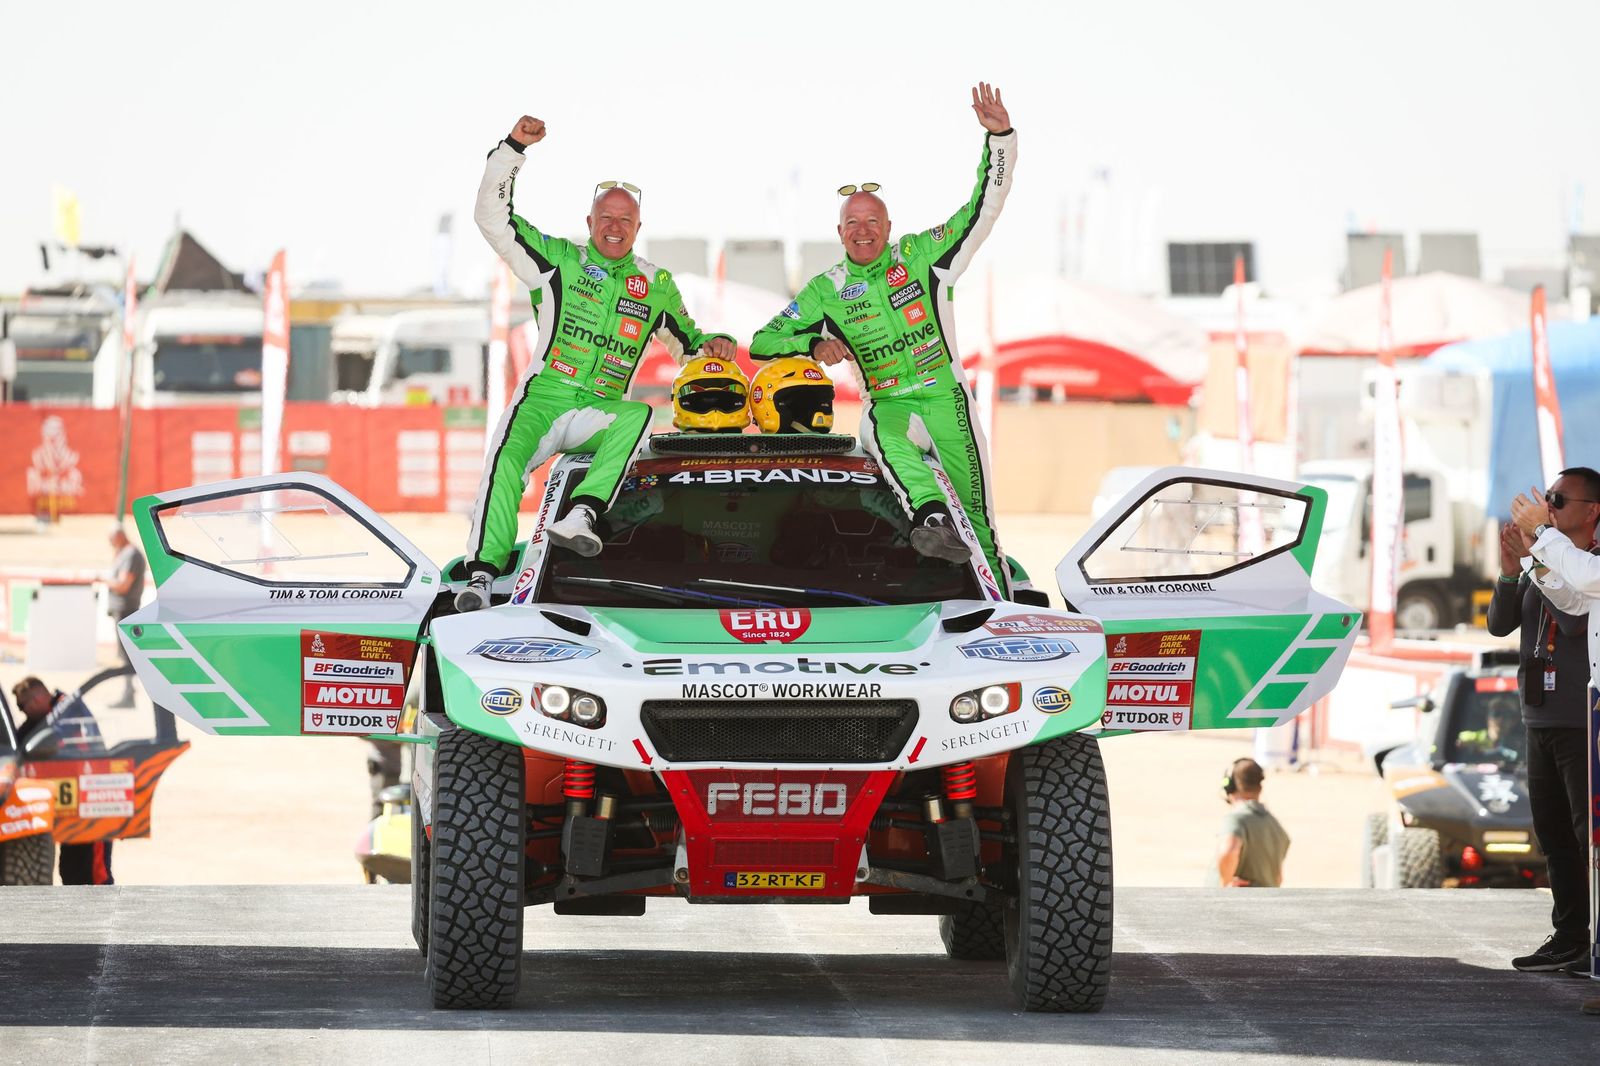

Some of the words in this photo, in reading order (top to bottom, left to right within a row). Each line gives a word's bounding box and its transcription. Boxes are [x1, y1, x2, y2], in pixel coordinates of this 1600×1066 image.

[568, 284, 594, 298] KEUKEN
[577, 276, 604, 293] DHG
[628, 278, 646, 294] ERU
[893, 288, 922, 308] WORKWEAR
[618, 306, 648, 319] WORKWEAR
[845, 300, 872, 315] DHG
[908, 307, 924, 320] JBL
[844, 313, 868, 325] KEUKEN
[624, 322, 638, 336] JBL
[562, 318, 638, 359] Emotive
[859, 322, 935, 363] Emotive
[552, 360, 574, 374] FEBO
[705, 364, 722, 372] ERU
[805, 370, 822, 379] ERU
[681, 458, 732, 466] DREAM.
[965, 443, 981, 514] WORKWEAR
[269, 590, 293, 599] TIM
[295, 590, 306, 599] &
[309, 590, 338, 599] TOM
[342, 590, 404, 599] CORONEL
[1091, 587, 1116, 596] TIM
[1127, 584, 1157, 594] TOM
[1158, 582, 1216, 593] CORONEL
[730, 609, 802, 630] ERU
[360, 639, 393, 648] DREAM.
[314, 663, 394, 675] BFGoodrich
[642, 658, 918, 675] Emotive
[1111, 662, 1186, 672] BFGoodrich
[316, 687, 392, 704] MOTUL
[772, 683, 881, 698] WORKWEAR
[1108, 685, 1180, 701] MOTUL
[485, 696, 522, 706] HELLA
[1036, 694, 1072, 704] HELLA
[326, 715, 383, 727] TUDOR
[1116, 712, 1169, 723] TUDOR
[524, 721, 613, 751] SERENGETI
[941, 720, 1028, 751] SERENGETI
[707, 782, 847, 815] FEBO
[738, 874, 822, 886] 32-RT-KF
